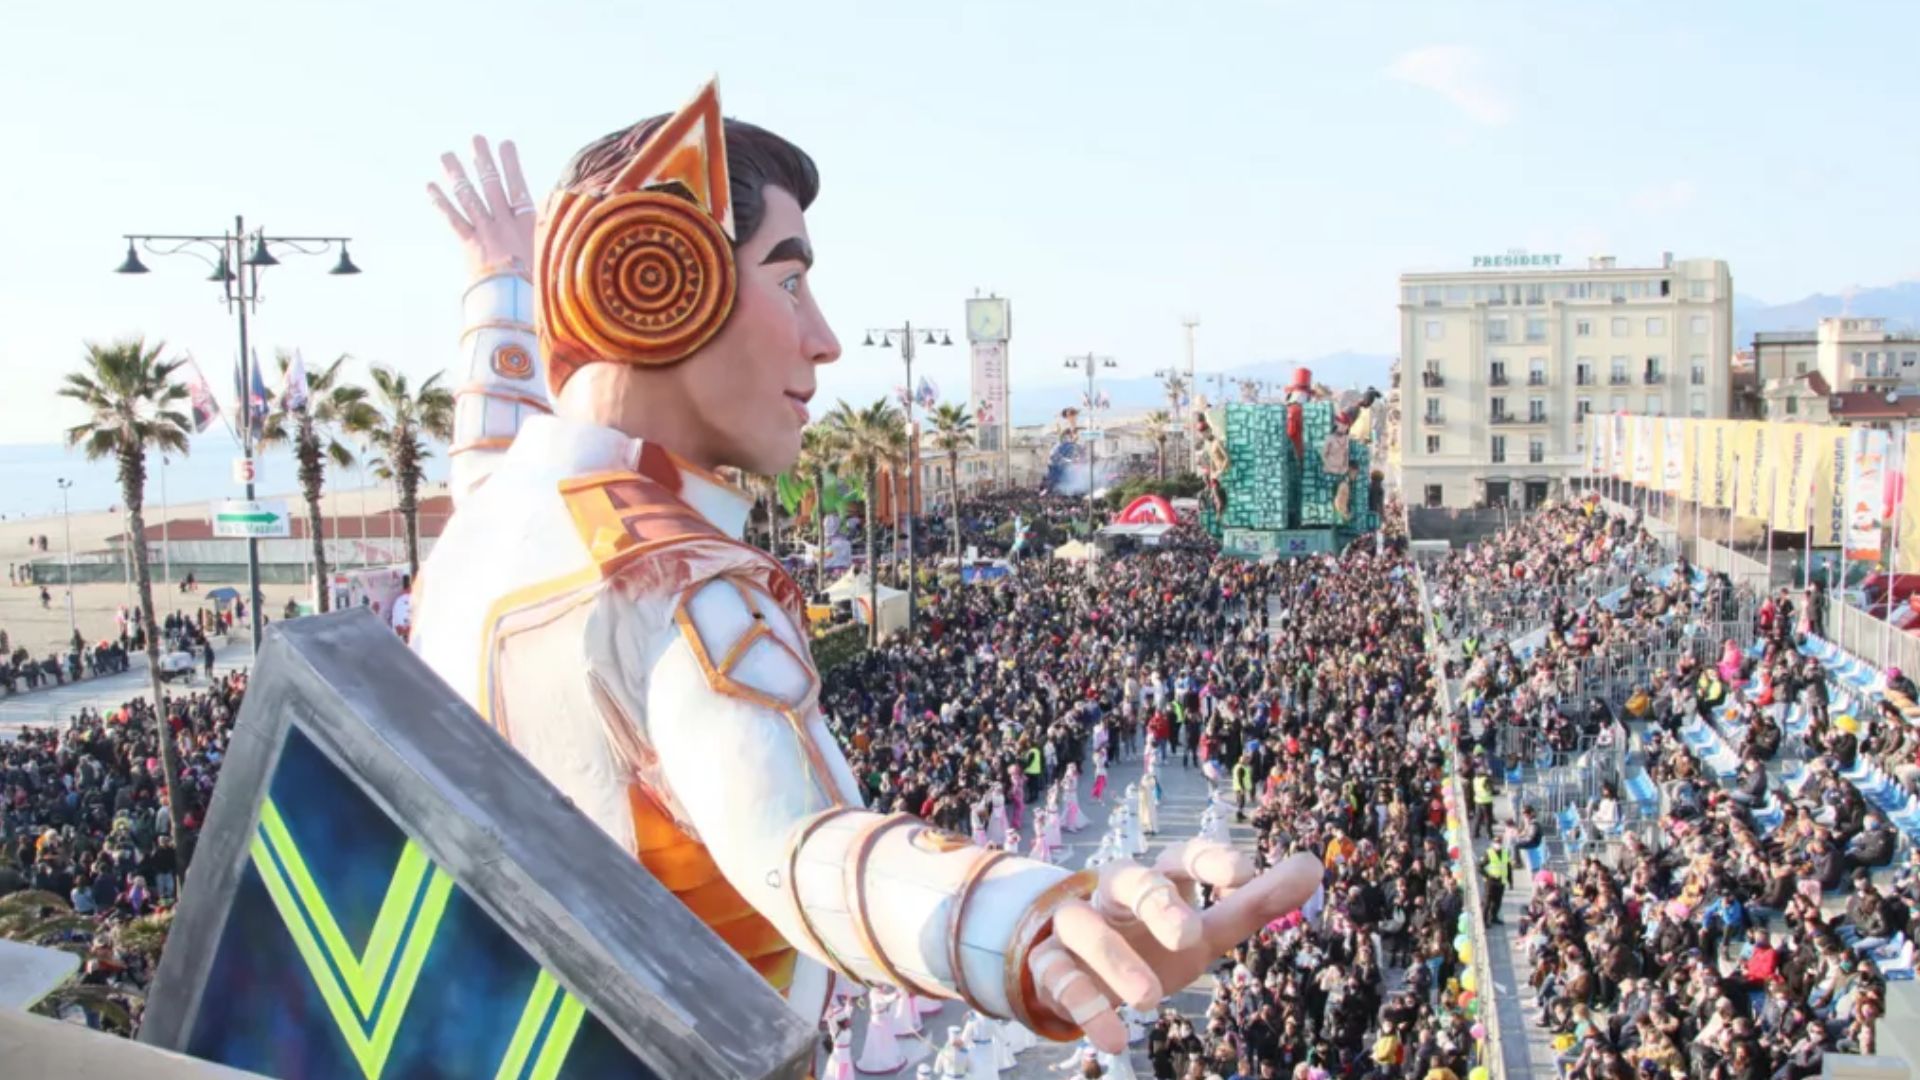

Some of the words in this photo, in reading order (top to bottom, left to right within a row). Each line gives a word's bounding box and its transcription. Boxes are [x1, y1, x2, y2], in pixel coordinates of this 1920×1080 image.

[1473, 254, 1562, 267] PRESIDENT
[240, 460, 255, 481] 5
[1831, 437, 1845, 543] ESSELUNGA
